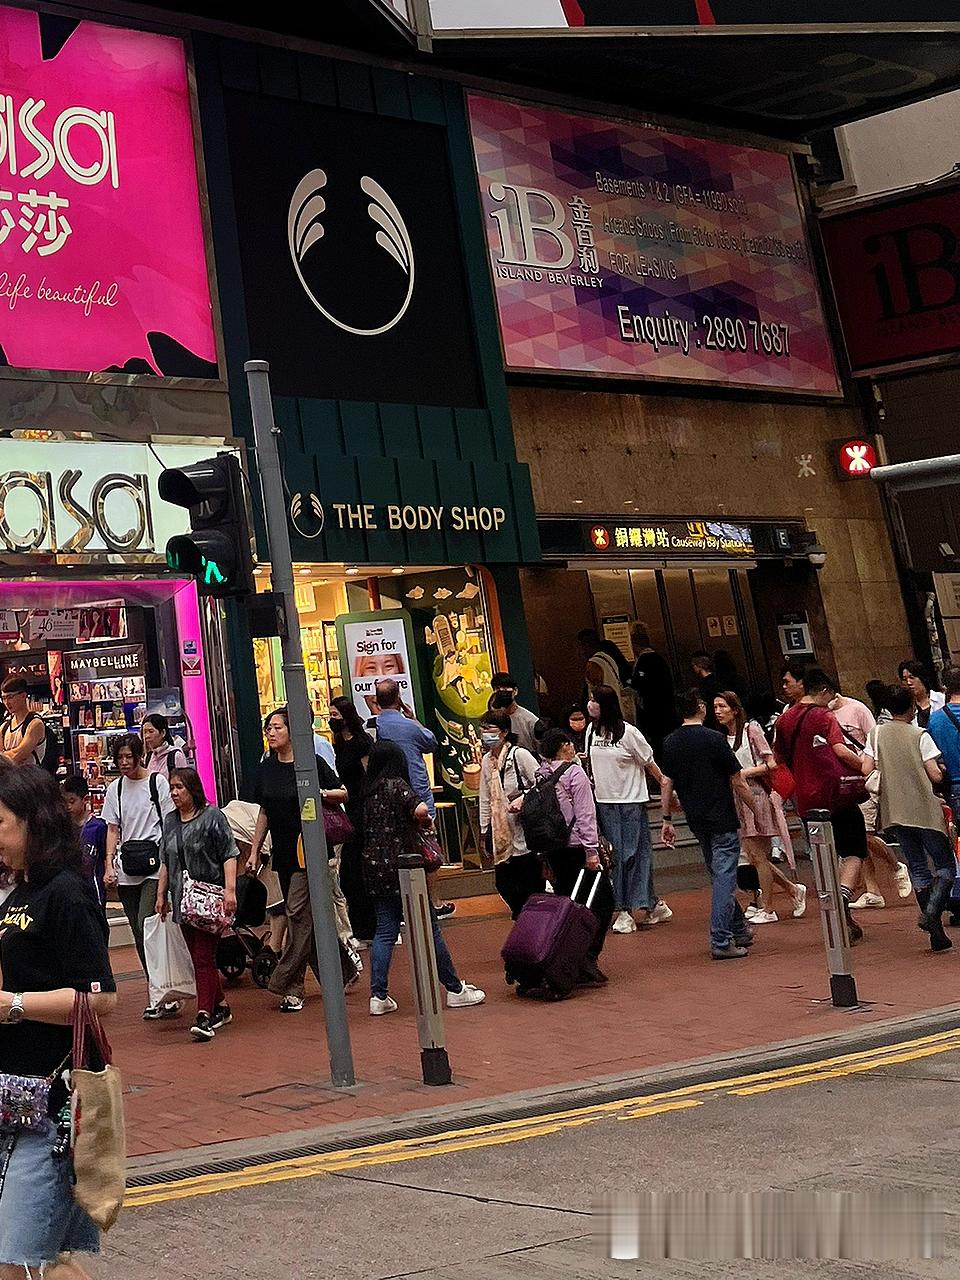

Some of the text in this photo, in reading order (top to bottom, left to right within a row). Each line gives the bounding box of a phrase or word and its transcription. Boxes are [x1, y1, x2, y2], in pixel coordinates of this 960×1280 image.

[595, 171, 646, 199] Basements
[495, 266, 604, 288] ISLAND BEVERLEY
[37, 274, 120, 317] beautiful
[617, 304, 792, 357] Enquiry 2890 7687
[332, 503, 506, 531] THE BODY SHOP
[671, 535, 706, 550] Causeway
[780, 531, 788, 546] E
[356, 638, 397, 655] Sign for
[790, 631, 801, 648] E
[71, 653, 139, 670] MAYBELLINE
[354, 681, 373, 693] our
